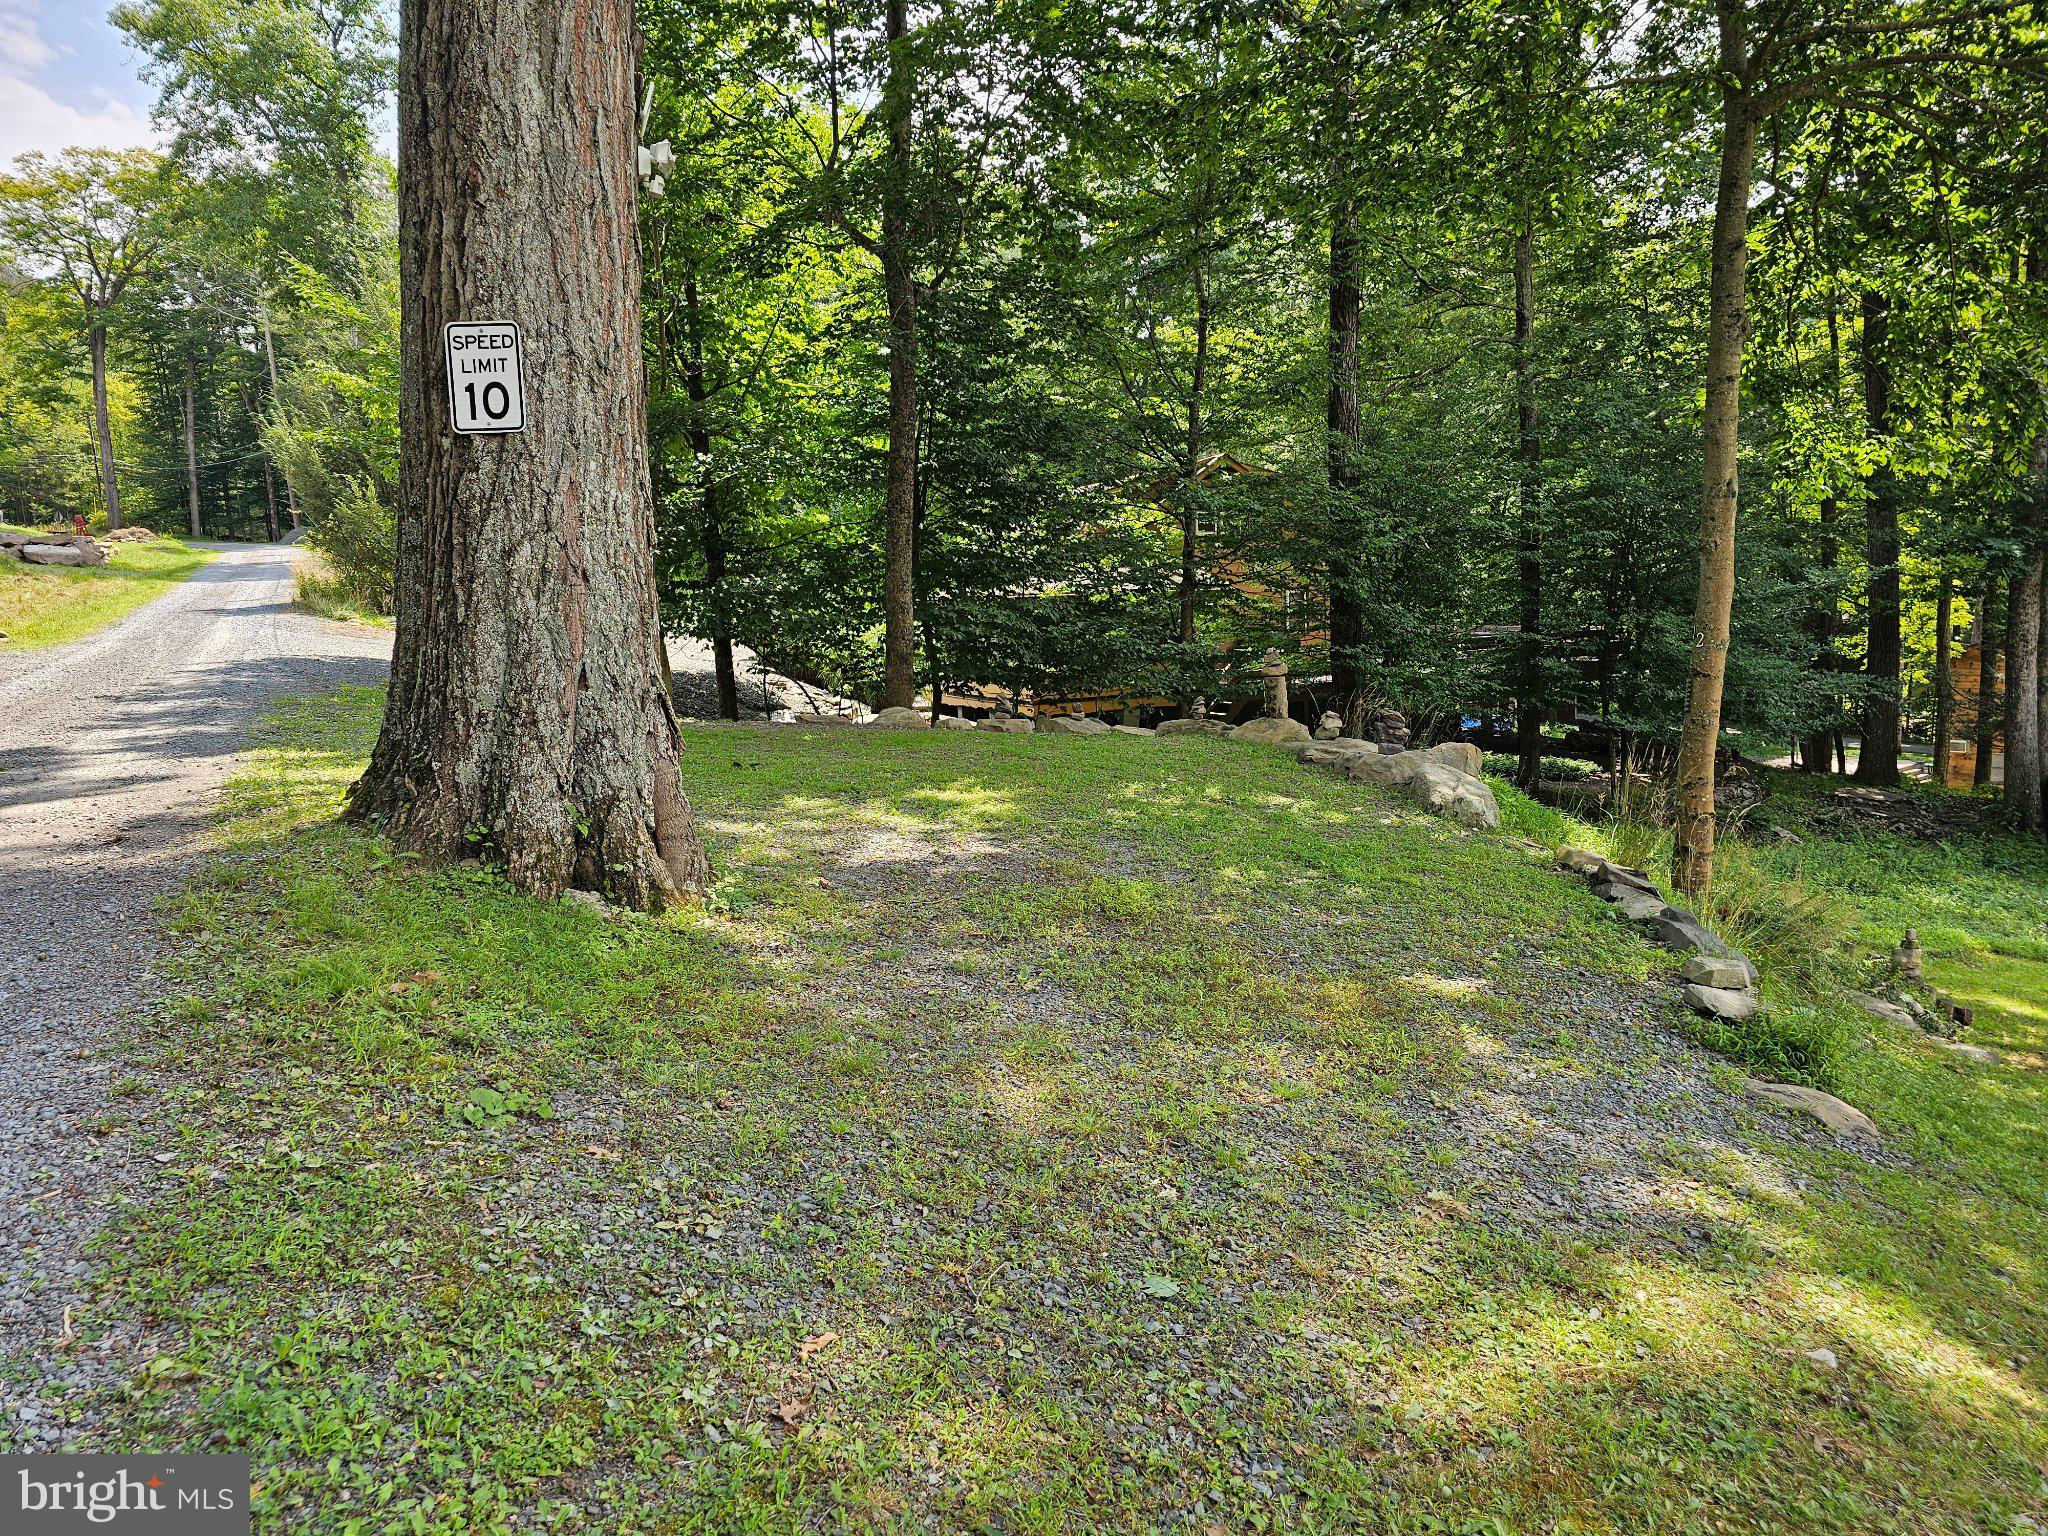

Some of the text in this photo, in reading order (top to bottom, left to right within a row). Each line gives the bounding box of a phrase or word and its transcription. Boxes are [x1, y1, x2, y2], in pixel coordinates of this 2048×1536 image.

[452, 334, 514, 350] SPEED
[461, 357, 508, 373] LIMIT
[464, 381, 510, 420] 10
